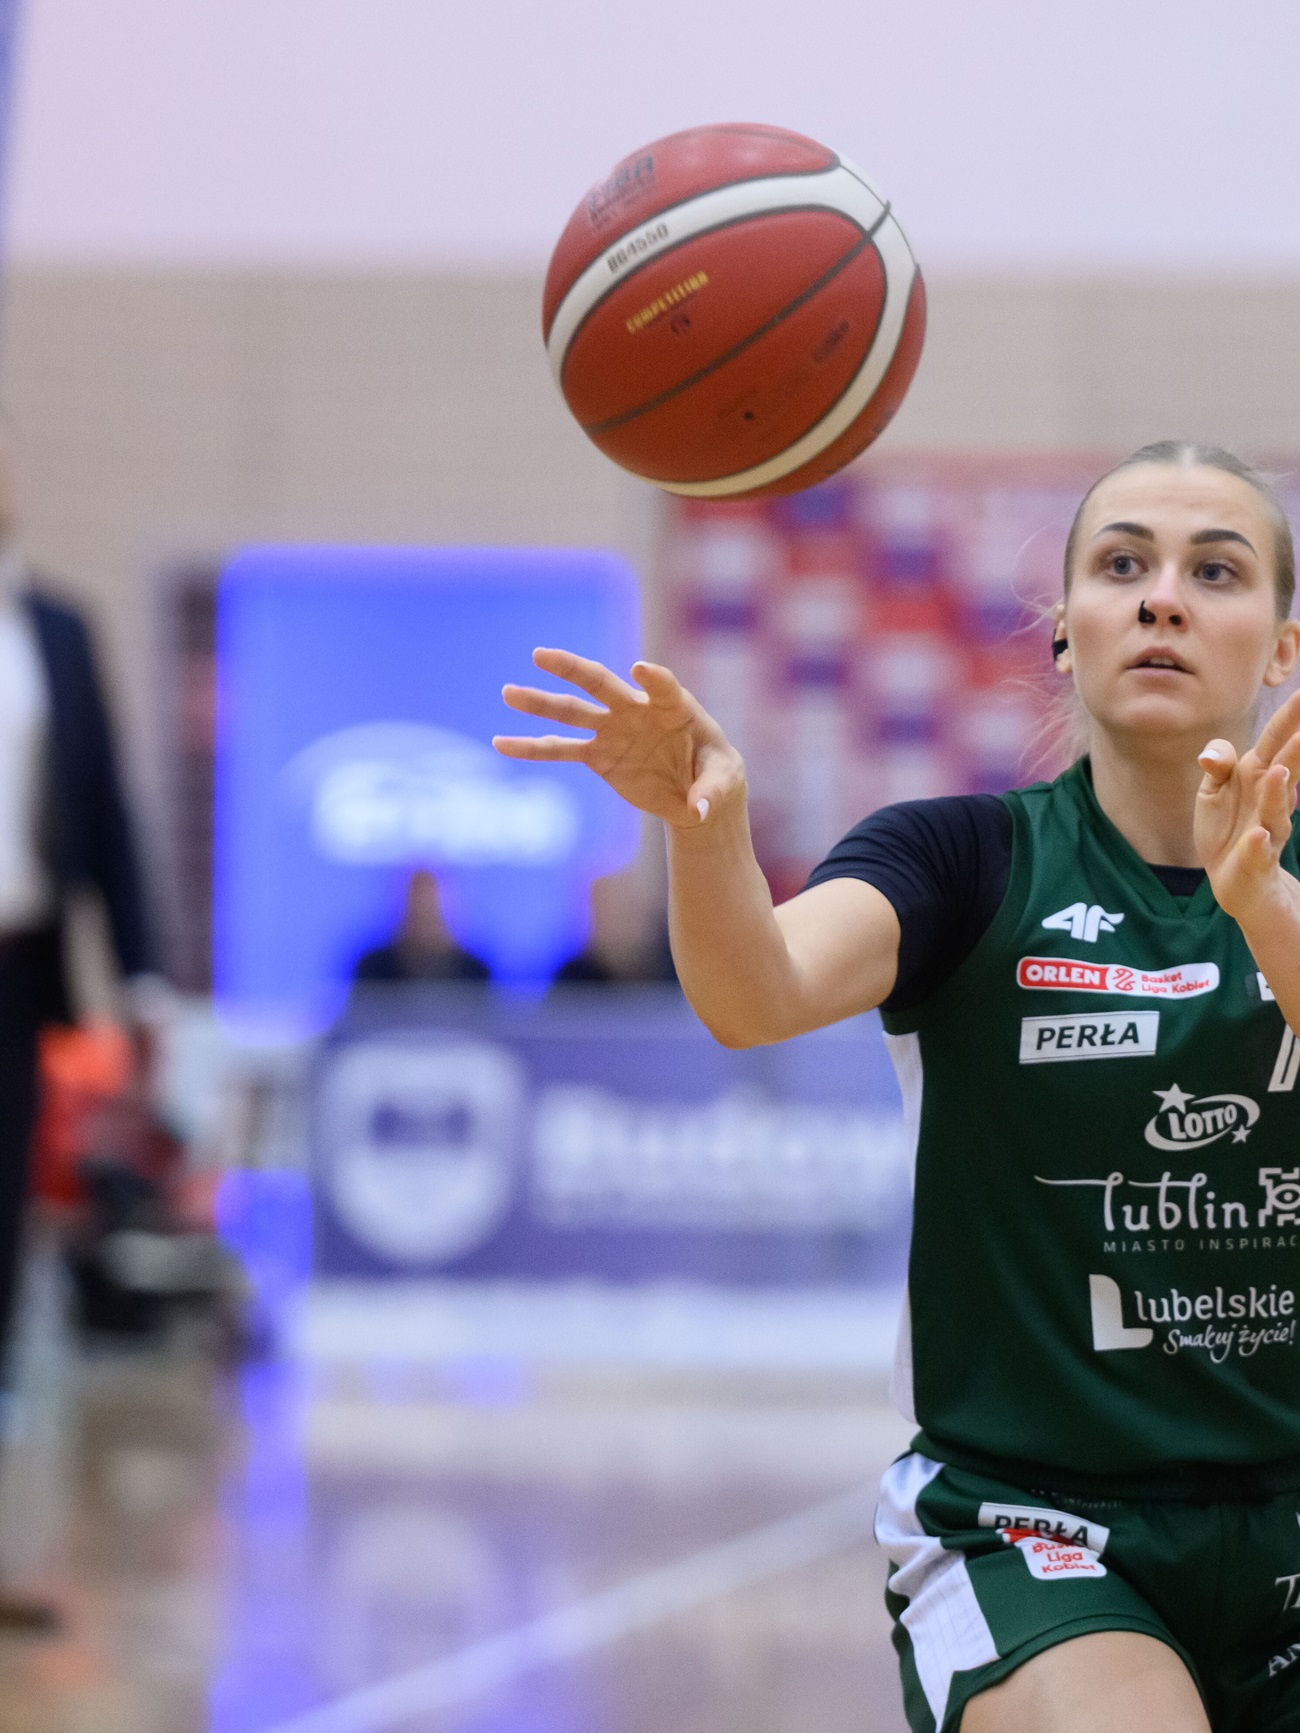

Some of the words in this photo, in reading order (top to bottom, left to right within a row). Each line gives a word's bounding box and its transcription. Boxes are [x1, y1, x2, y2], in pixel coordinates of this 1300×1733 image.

[626, 270, 709, 335] COMPETITION
[1025, 963, 1101, 986] ORLEN
[1140, 971, 1183, 984] Basket
[1141, 983, 1168, 994] Liga
[1171, 978, 1211, 994] Kobiet
[1035, 1021, 1140, 1051] PERŁA
[1168, 1104, 1238, 1140] LOTTO
[1103, 1239, 1185, 1253] MIASTO
[1163, 1323, 1237, 1364] Smakuj
[1238, 1319, 1297, 1357] życie!
[1046, 1551, 1084, 1564] Liga
[1041, 1561, 1097, 1574] Kobiet
